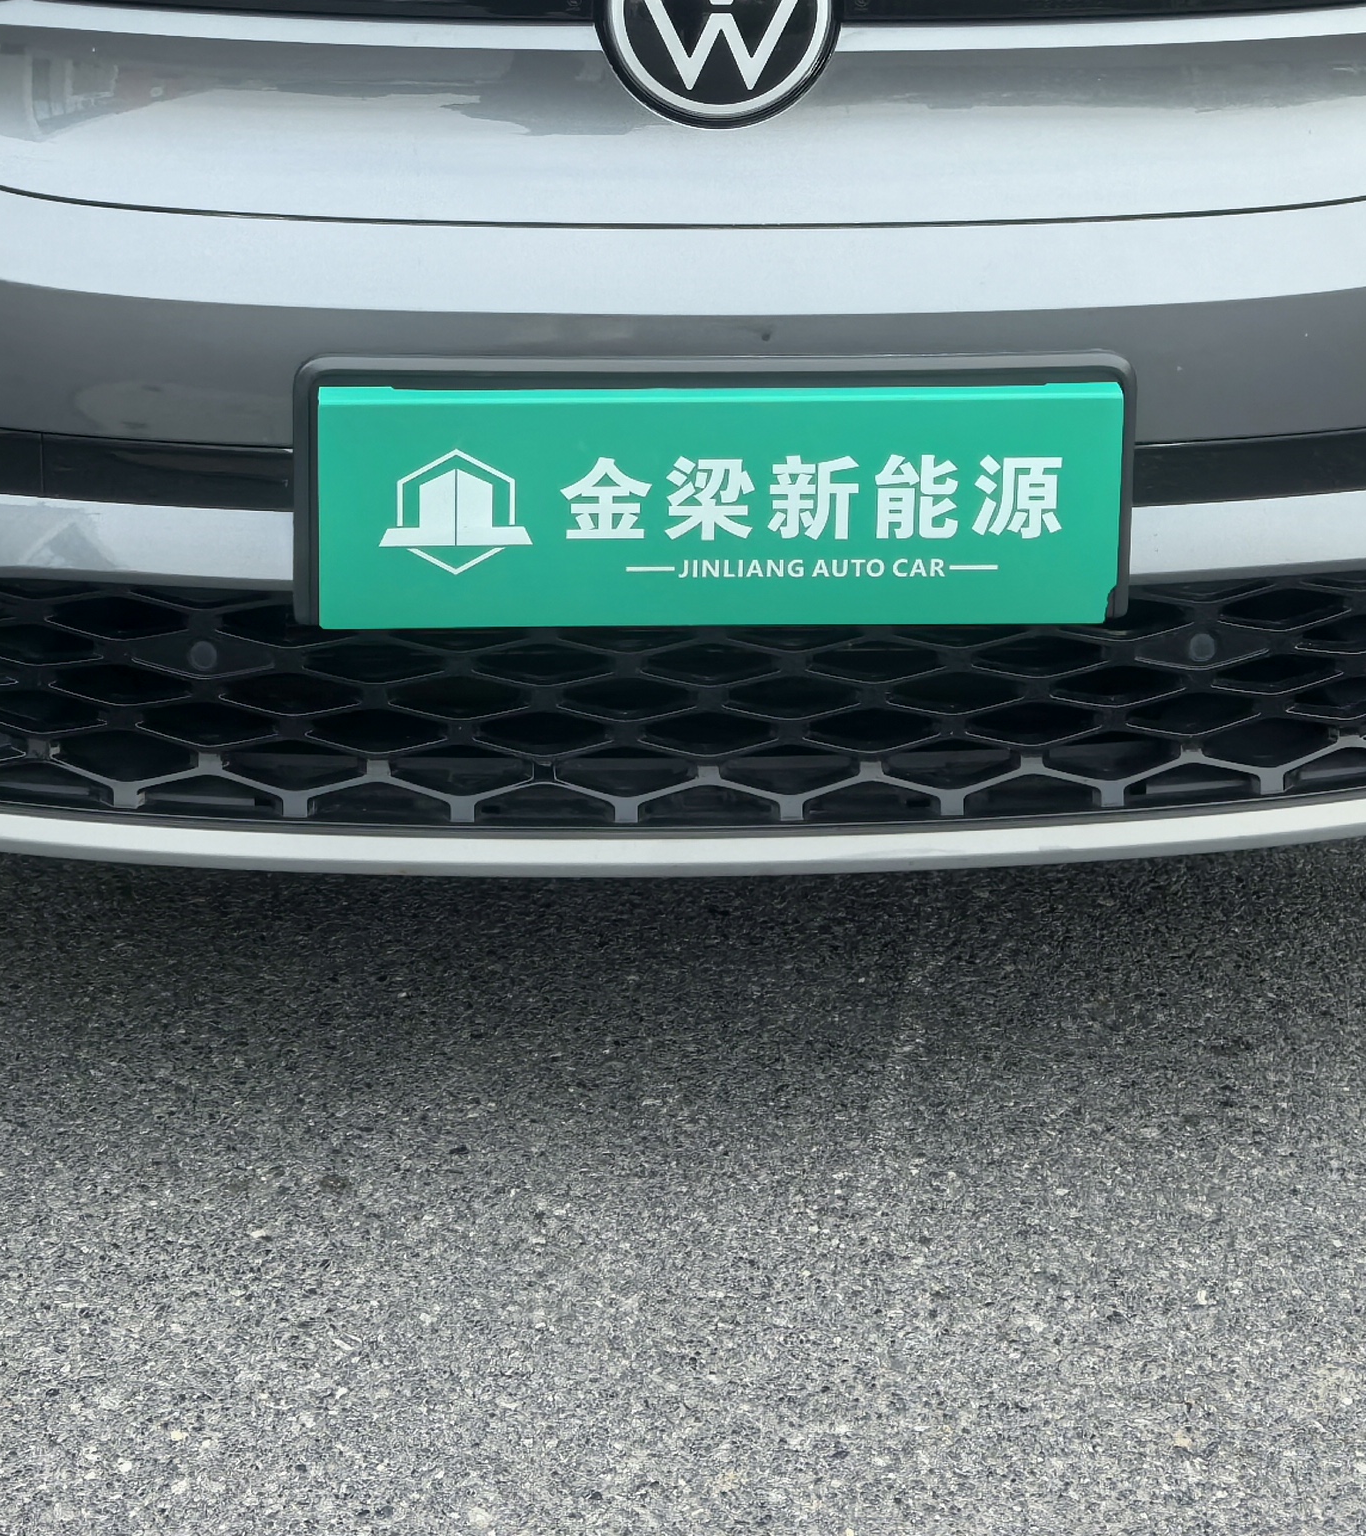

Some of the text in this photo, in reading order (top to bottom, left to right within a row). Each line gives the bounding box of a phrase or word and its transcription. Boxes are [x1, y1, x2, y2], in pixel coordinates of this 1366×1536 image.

[560, 452, 1064, 542] 金梁新能源
[678, 557, 946, 579] JINLIANG AUTO CAR
